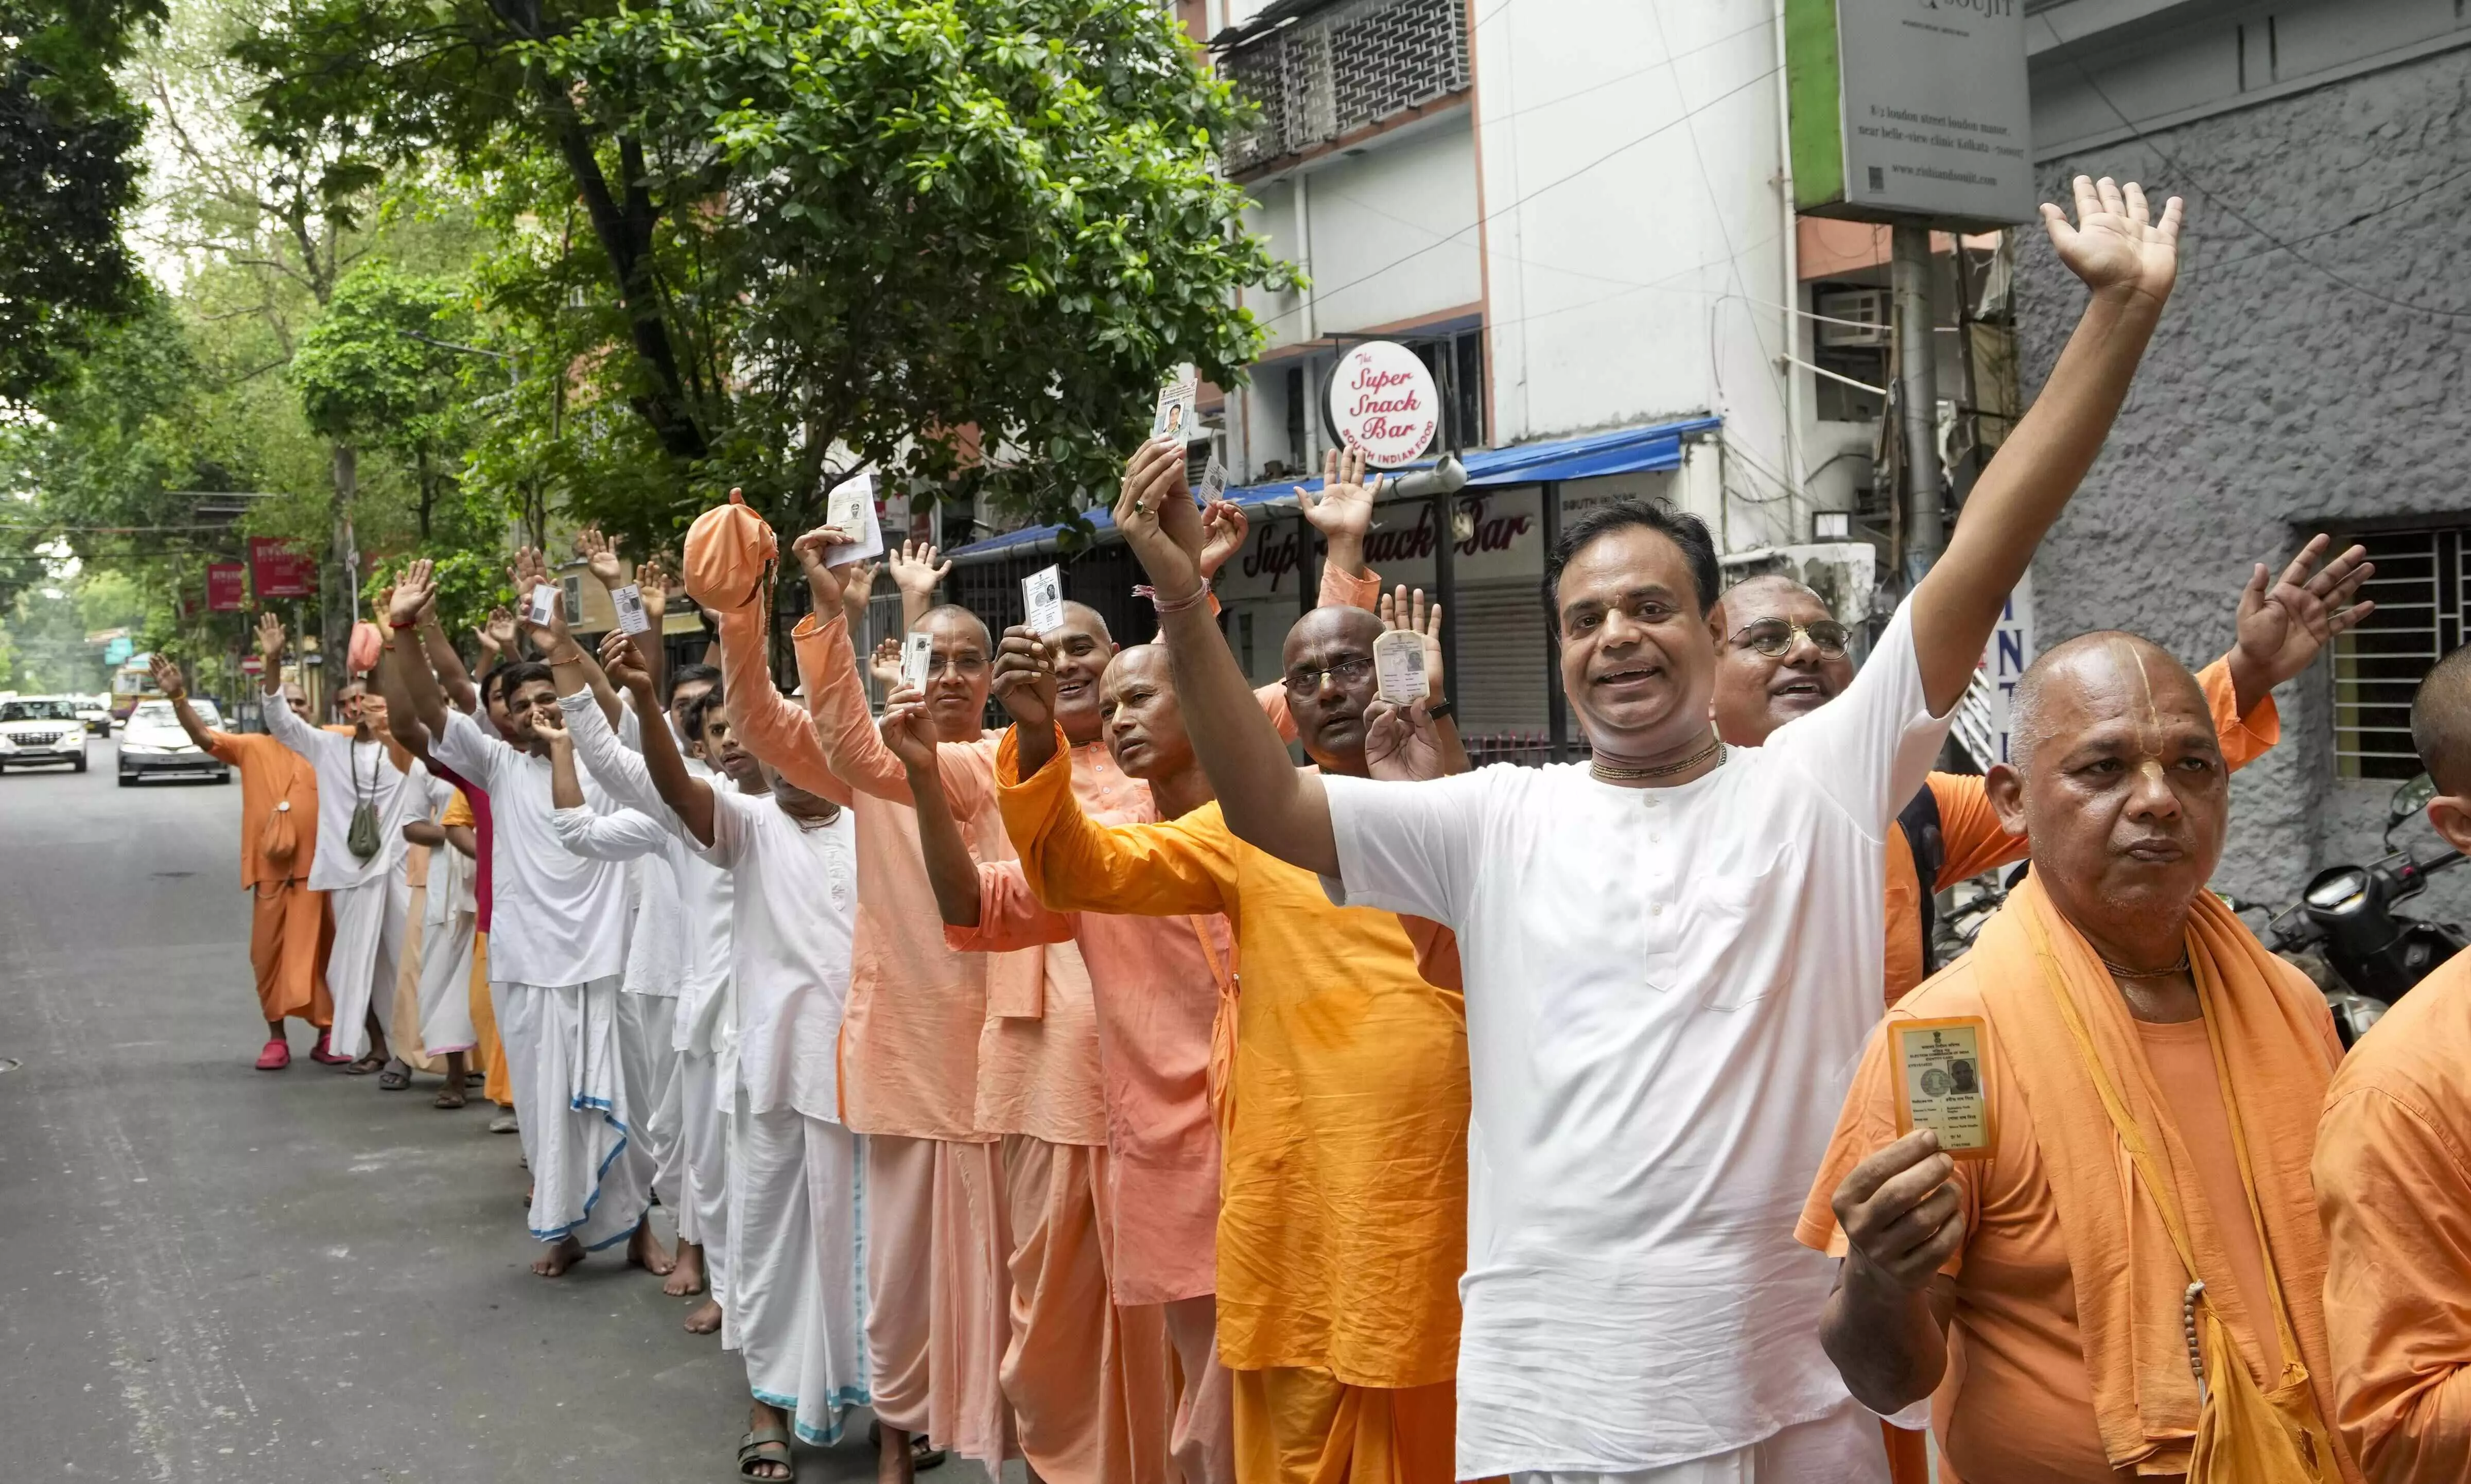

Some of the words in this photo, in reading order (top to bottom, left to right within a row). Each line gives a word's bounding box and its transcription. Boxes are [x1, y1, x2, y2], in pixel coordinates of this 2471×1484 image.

[1943, 0, 2013, 18] OUJIT
[1887, 106, 1918, 123] london
[1921, 114, 1946, 127] street
[1948, 115, 1978, 131] london
[1857, 126, 1879, 137] near
[1957, 138, 1989, 153] Kolkata
[1355, 352, 1372, 365] The
[1351, 367, 1414, 395] Super
[1350, 390, 1421, 416] Snack
[1361, 416, 1417, 440] Bar
[1377, 447, 1416, 464] INDIAN
[1415, 420, 1435, 450] FOOD
[1243, 523, 1328, 592] Sup
[1363, 500, 1436, 563] nack
[1453, 496, 1535, 556] Bar
